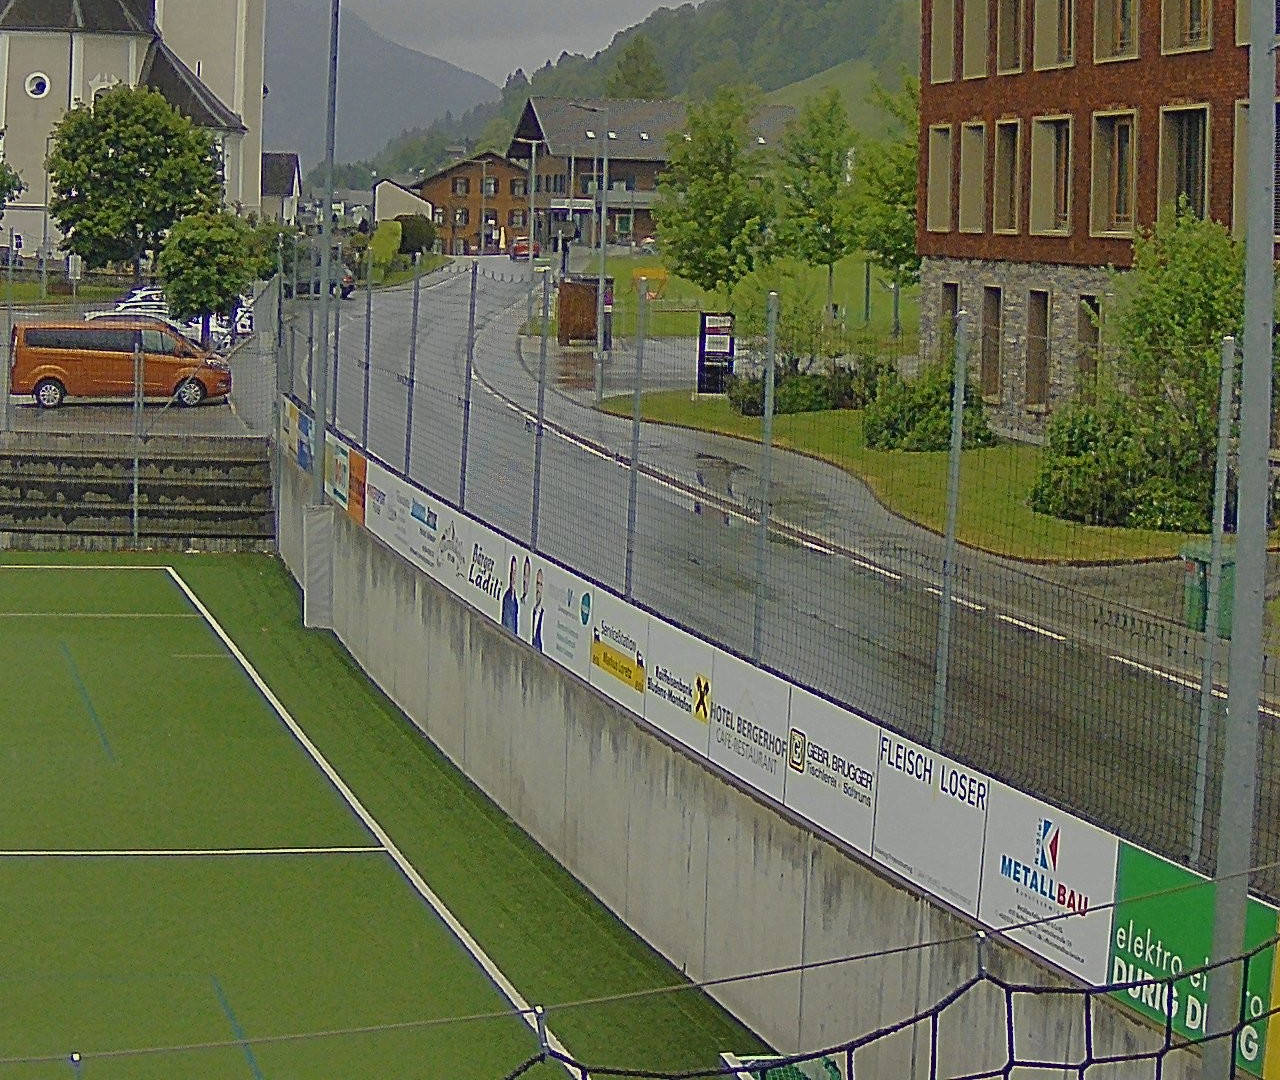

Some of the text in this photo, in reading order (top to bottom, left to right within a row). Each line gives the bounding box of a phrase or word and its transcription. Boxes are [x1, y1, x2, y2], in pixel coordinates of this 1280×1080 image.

[711, 702, 735, 731] HOTEL
[737, 716, 787, 757] BERGERHOF
[832, 755, 873, 791] BRUGGER
[880, 736, 987, 811] FLEISCH LOSER
[1116, 919, 1183, 976] elektro
